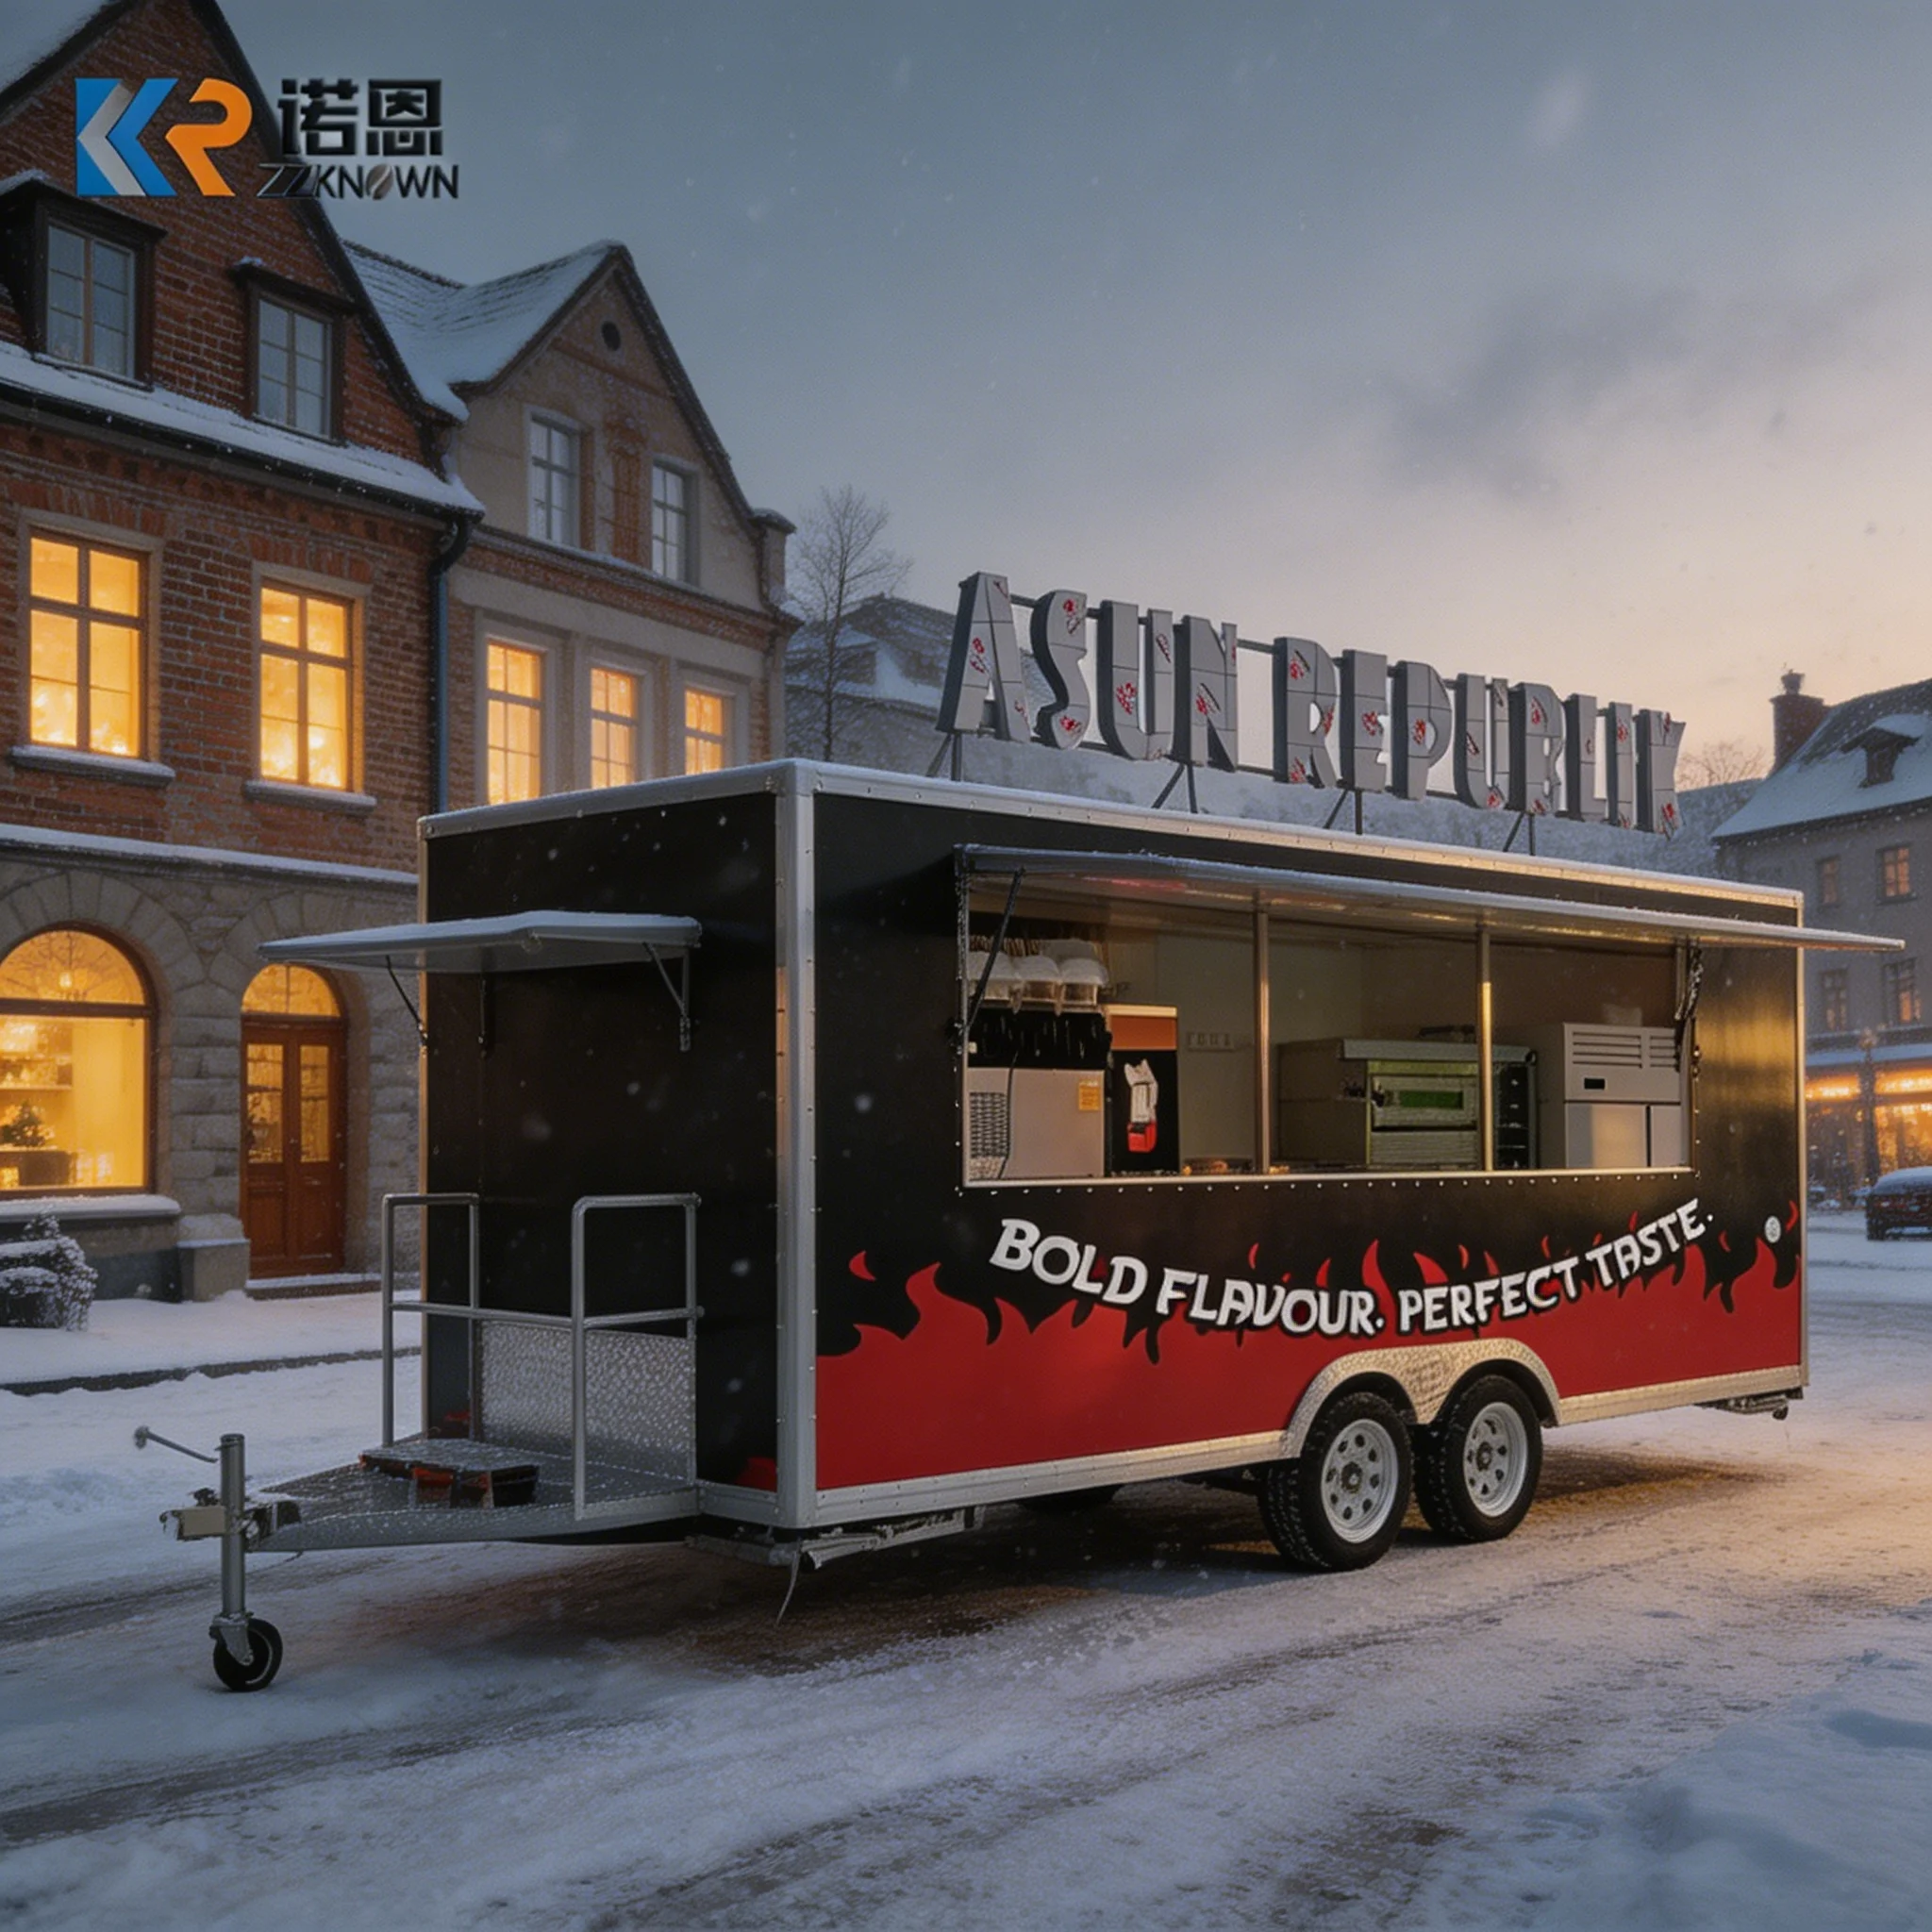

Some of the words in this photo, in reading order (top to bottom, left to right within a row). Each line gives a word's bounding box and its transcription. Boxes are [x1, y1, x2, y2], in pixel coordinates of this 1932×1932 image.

[935, 572, 1238, 772] ASUN
[989, 1219, 1149, 1305] BOLD
[1156, 1268, 1387, 1336] FLAVOUR.
[1399, 1257, 1579, 1332] PERFECT
[1586, 1198, 1714, 1287] TASTE.
